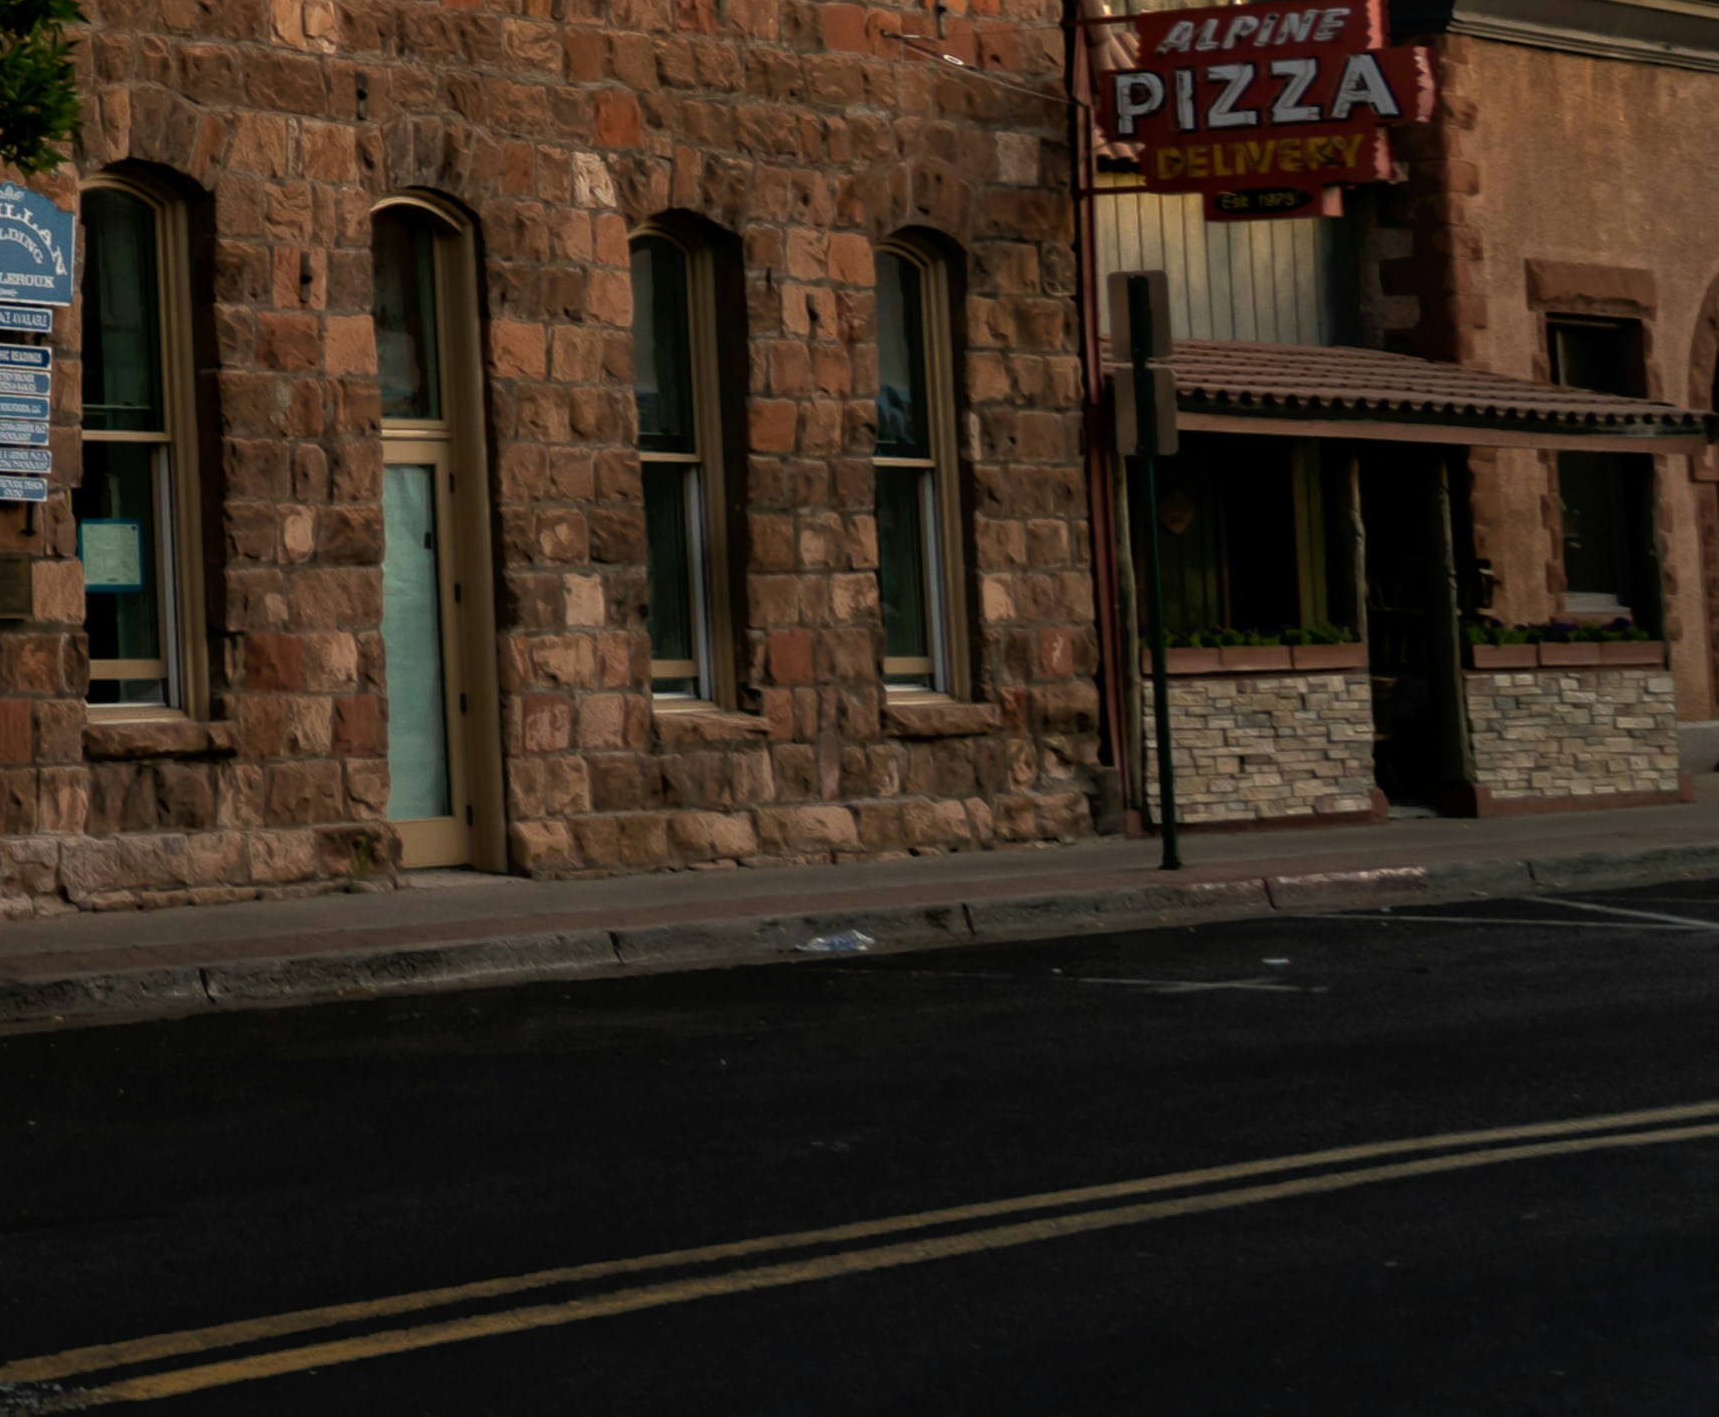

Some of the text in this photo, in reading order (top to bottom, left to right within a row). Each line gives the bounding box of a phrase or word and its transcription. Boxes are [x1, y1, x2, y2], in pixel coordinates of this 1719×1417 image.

[1154, 8, 1351, 56] ALPINE
[1113, 53, 1401, 135] PIZZA
[1155, 133, 1365, 180] DELIVERY
[11, 313, 48, 327] AVAILABLE
[10, 350, 43, 363] READINGS
